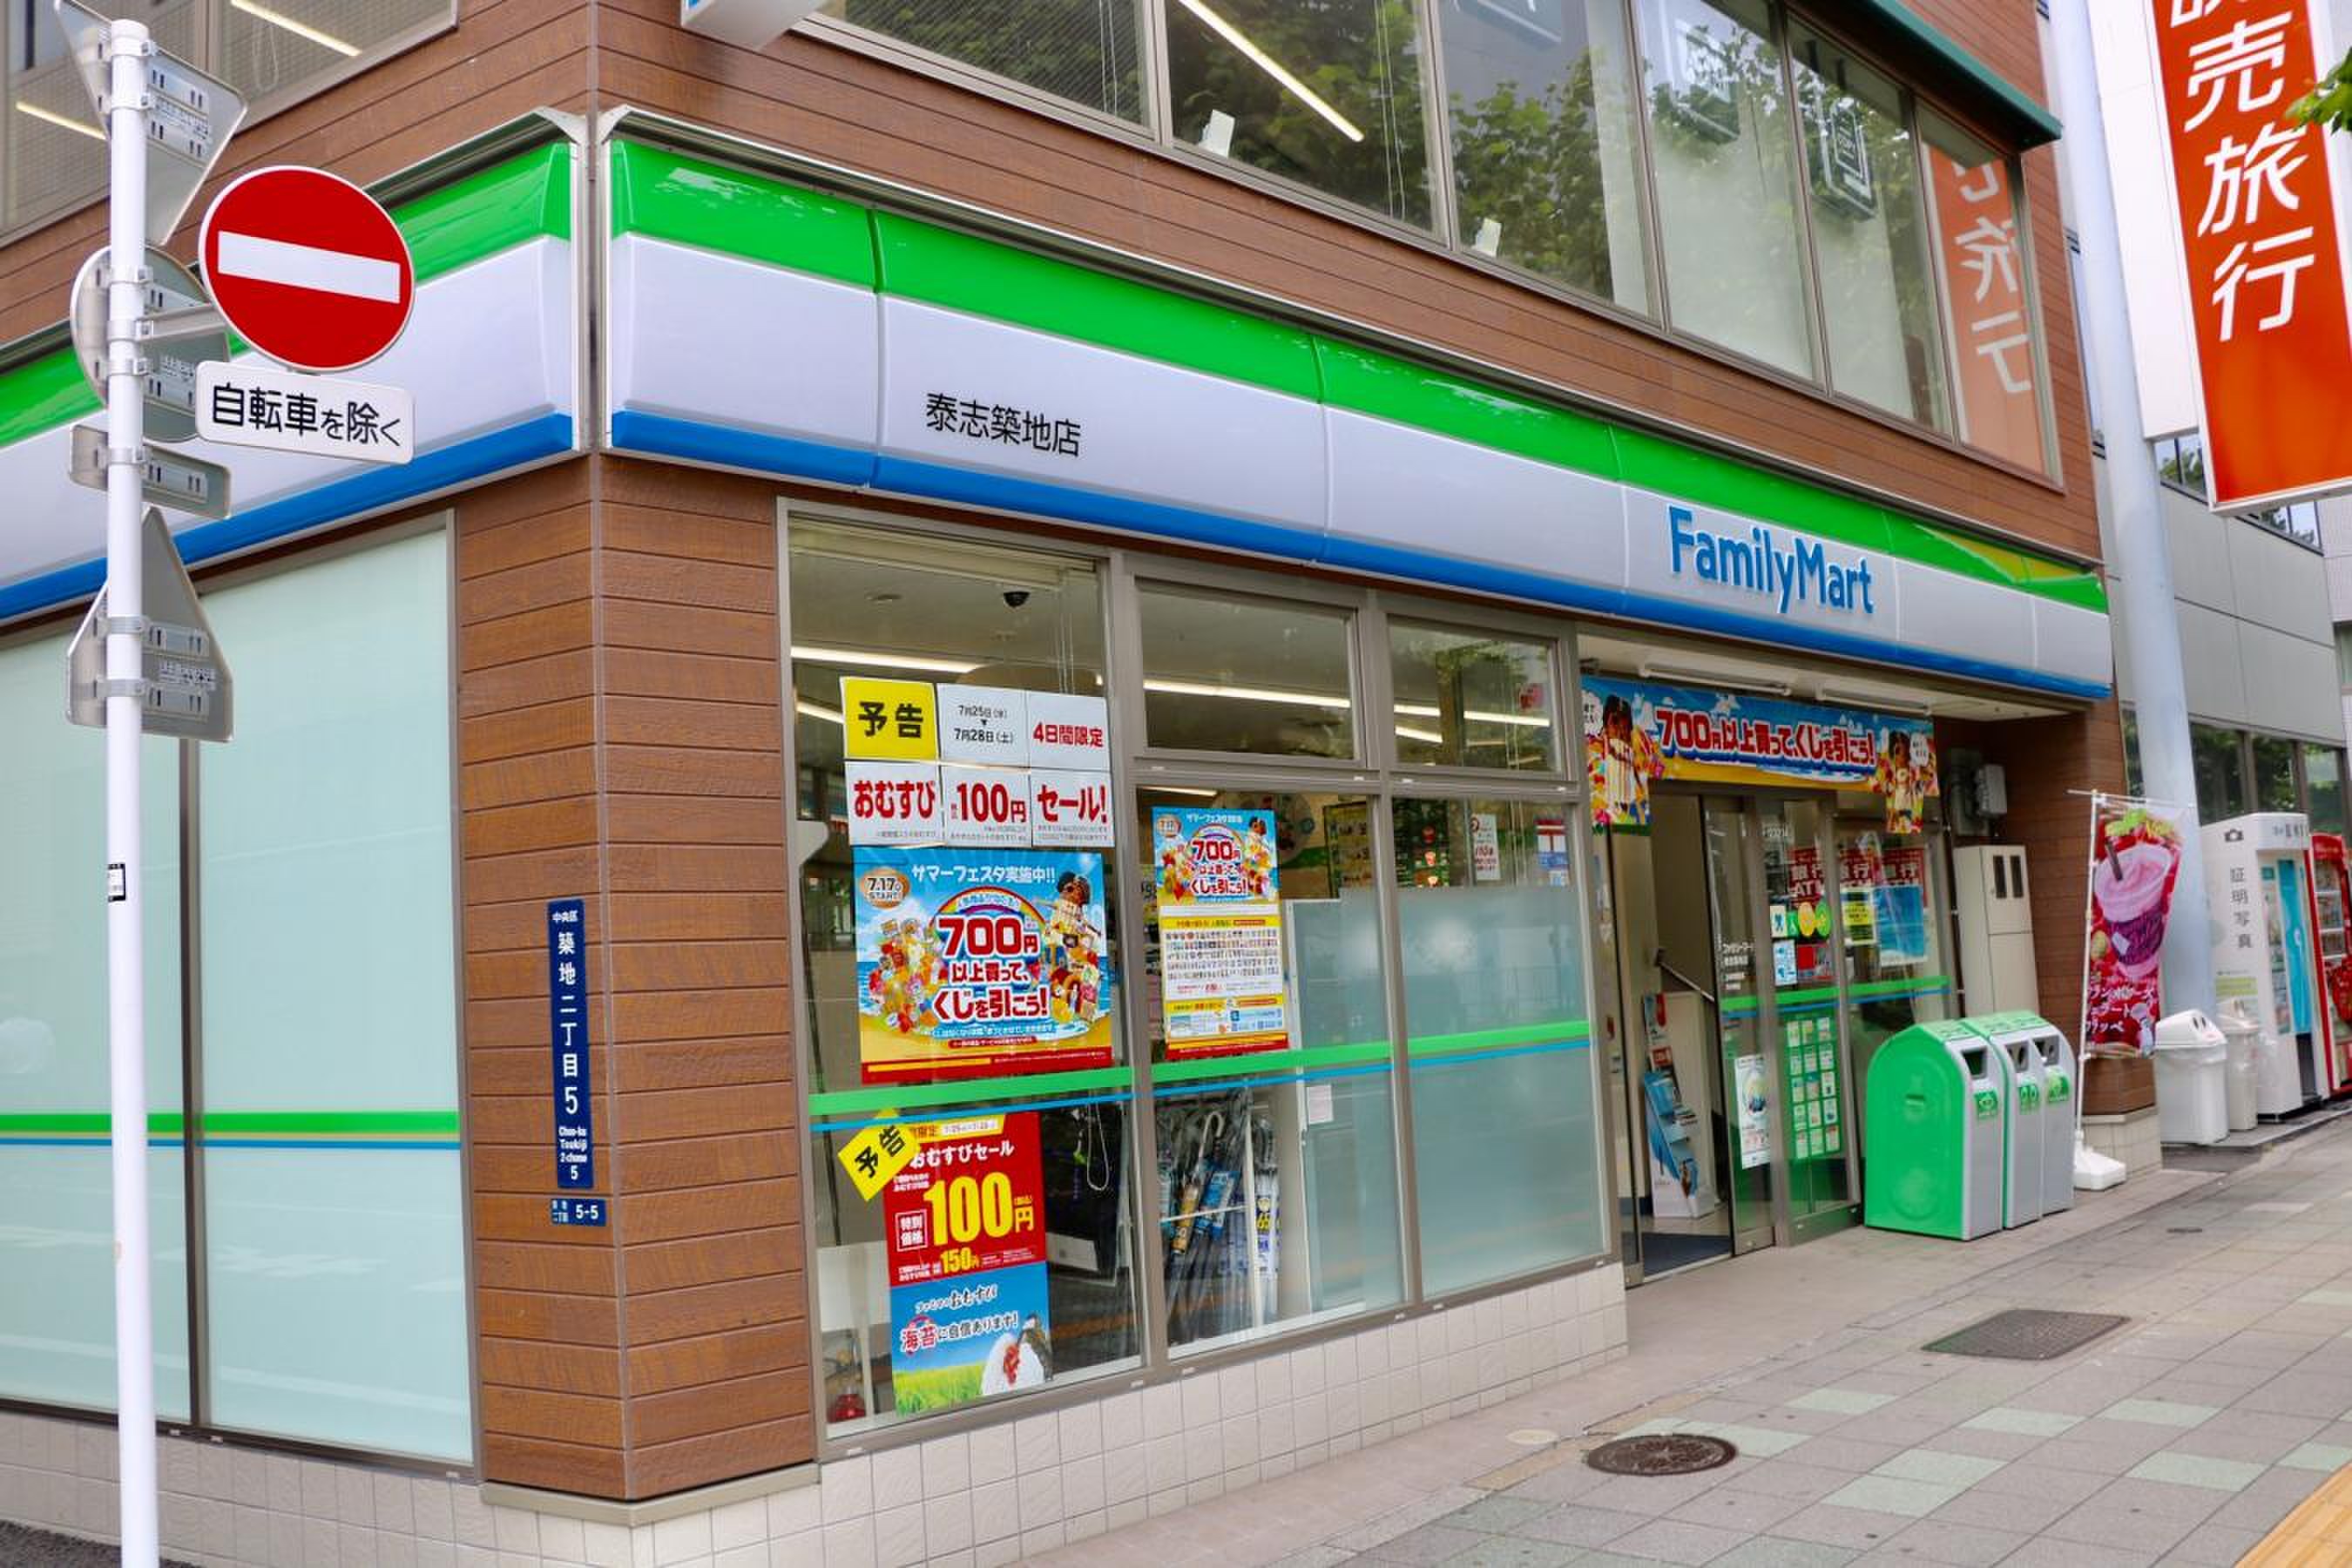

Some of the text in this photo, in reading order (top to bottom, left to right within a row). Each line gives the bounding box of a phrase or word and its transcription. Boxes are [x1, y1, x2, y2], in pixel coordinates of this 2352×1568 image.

[213, 382, 401, 446] 自転車を除く
[926, 392, 1082, 457] 泰志築地店
[1668, 504, 1875, 613] FamilyMart
[858, 700, 924, 739] 予告
[1033, 721, 1104, 748] 4日間限定
[854, 780, 936, 820] おむすび
[1037, 784, 1107, 824] セール!
[911, 863, 1057, 884] サマーフェスタ実施中!!
[938, 917, 1040, 956] 700円
[933, 986, 1049, 1020] くじを引こう!
[855, 1125, 906, 1178] 予告
[909, 1139, 1015, 1170] おむすびセール
[571, 1165, 579, 1180] 5
[575, 1204, 599, 1220] 5-5
[923, 1172, 1035, 1246] 100円
